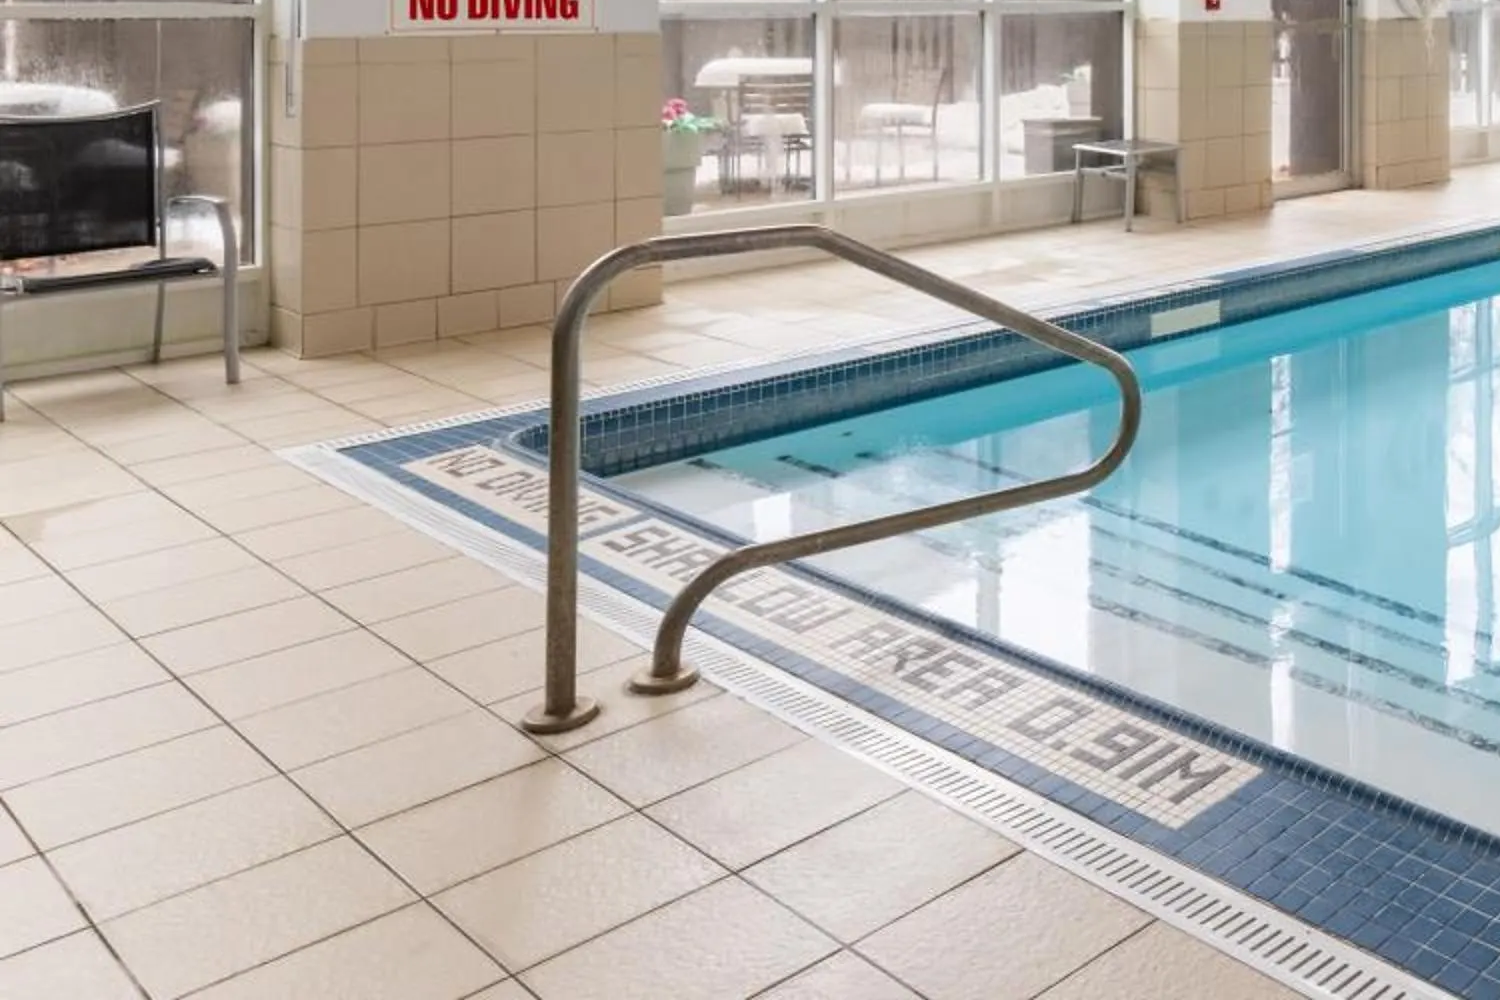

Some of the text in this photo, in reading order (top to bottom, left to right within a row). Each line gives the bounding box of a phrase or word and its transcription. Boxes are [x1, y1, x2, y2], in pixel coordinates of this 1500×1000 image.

[426, 449, 506, 479] NO
[603, 524, 1233, 802] SHALOW AREA 0.91M
